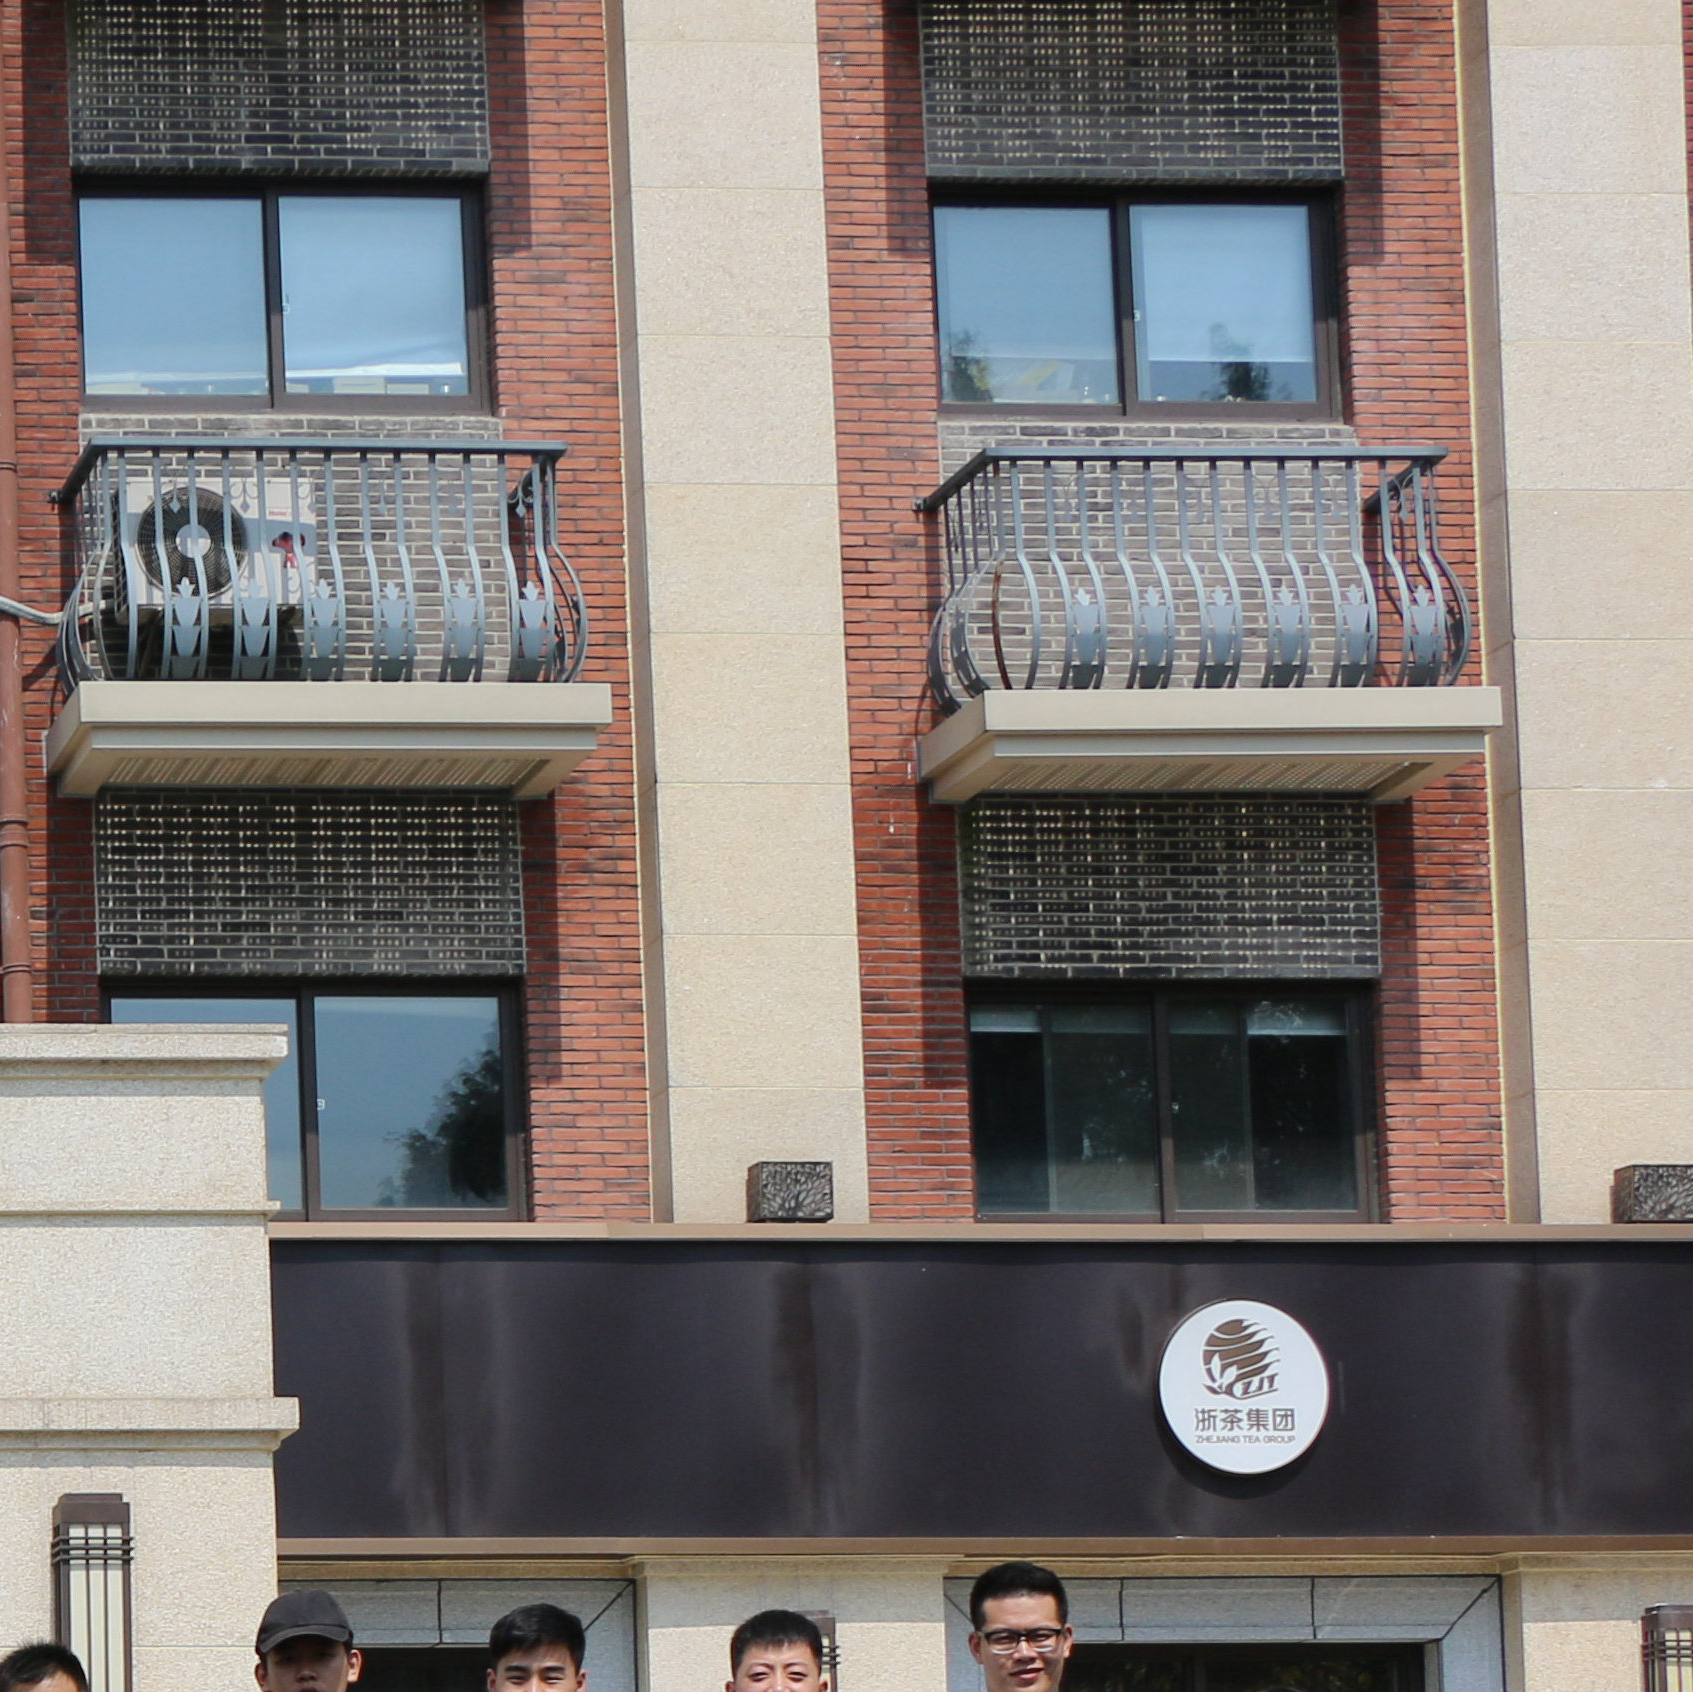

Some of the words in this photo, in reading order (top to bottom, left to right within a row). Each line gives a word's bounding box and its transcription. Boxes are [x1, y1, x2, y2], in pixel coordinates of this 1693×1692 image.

[1194, 1408, 1295, 1432] 浙茶集团
[1241, 1435, 1261, 1444] TEA
[1262, 1435, 1295, 1444] GROUP
